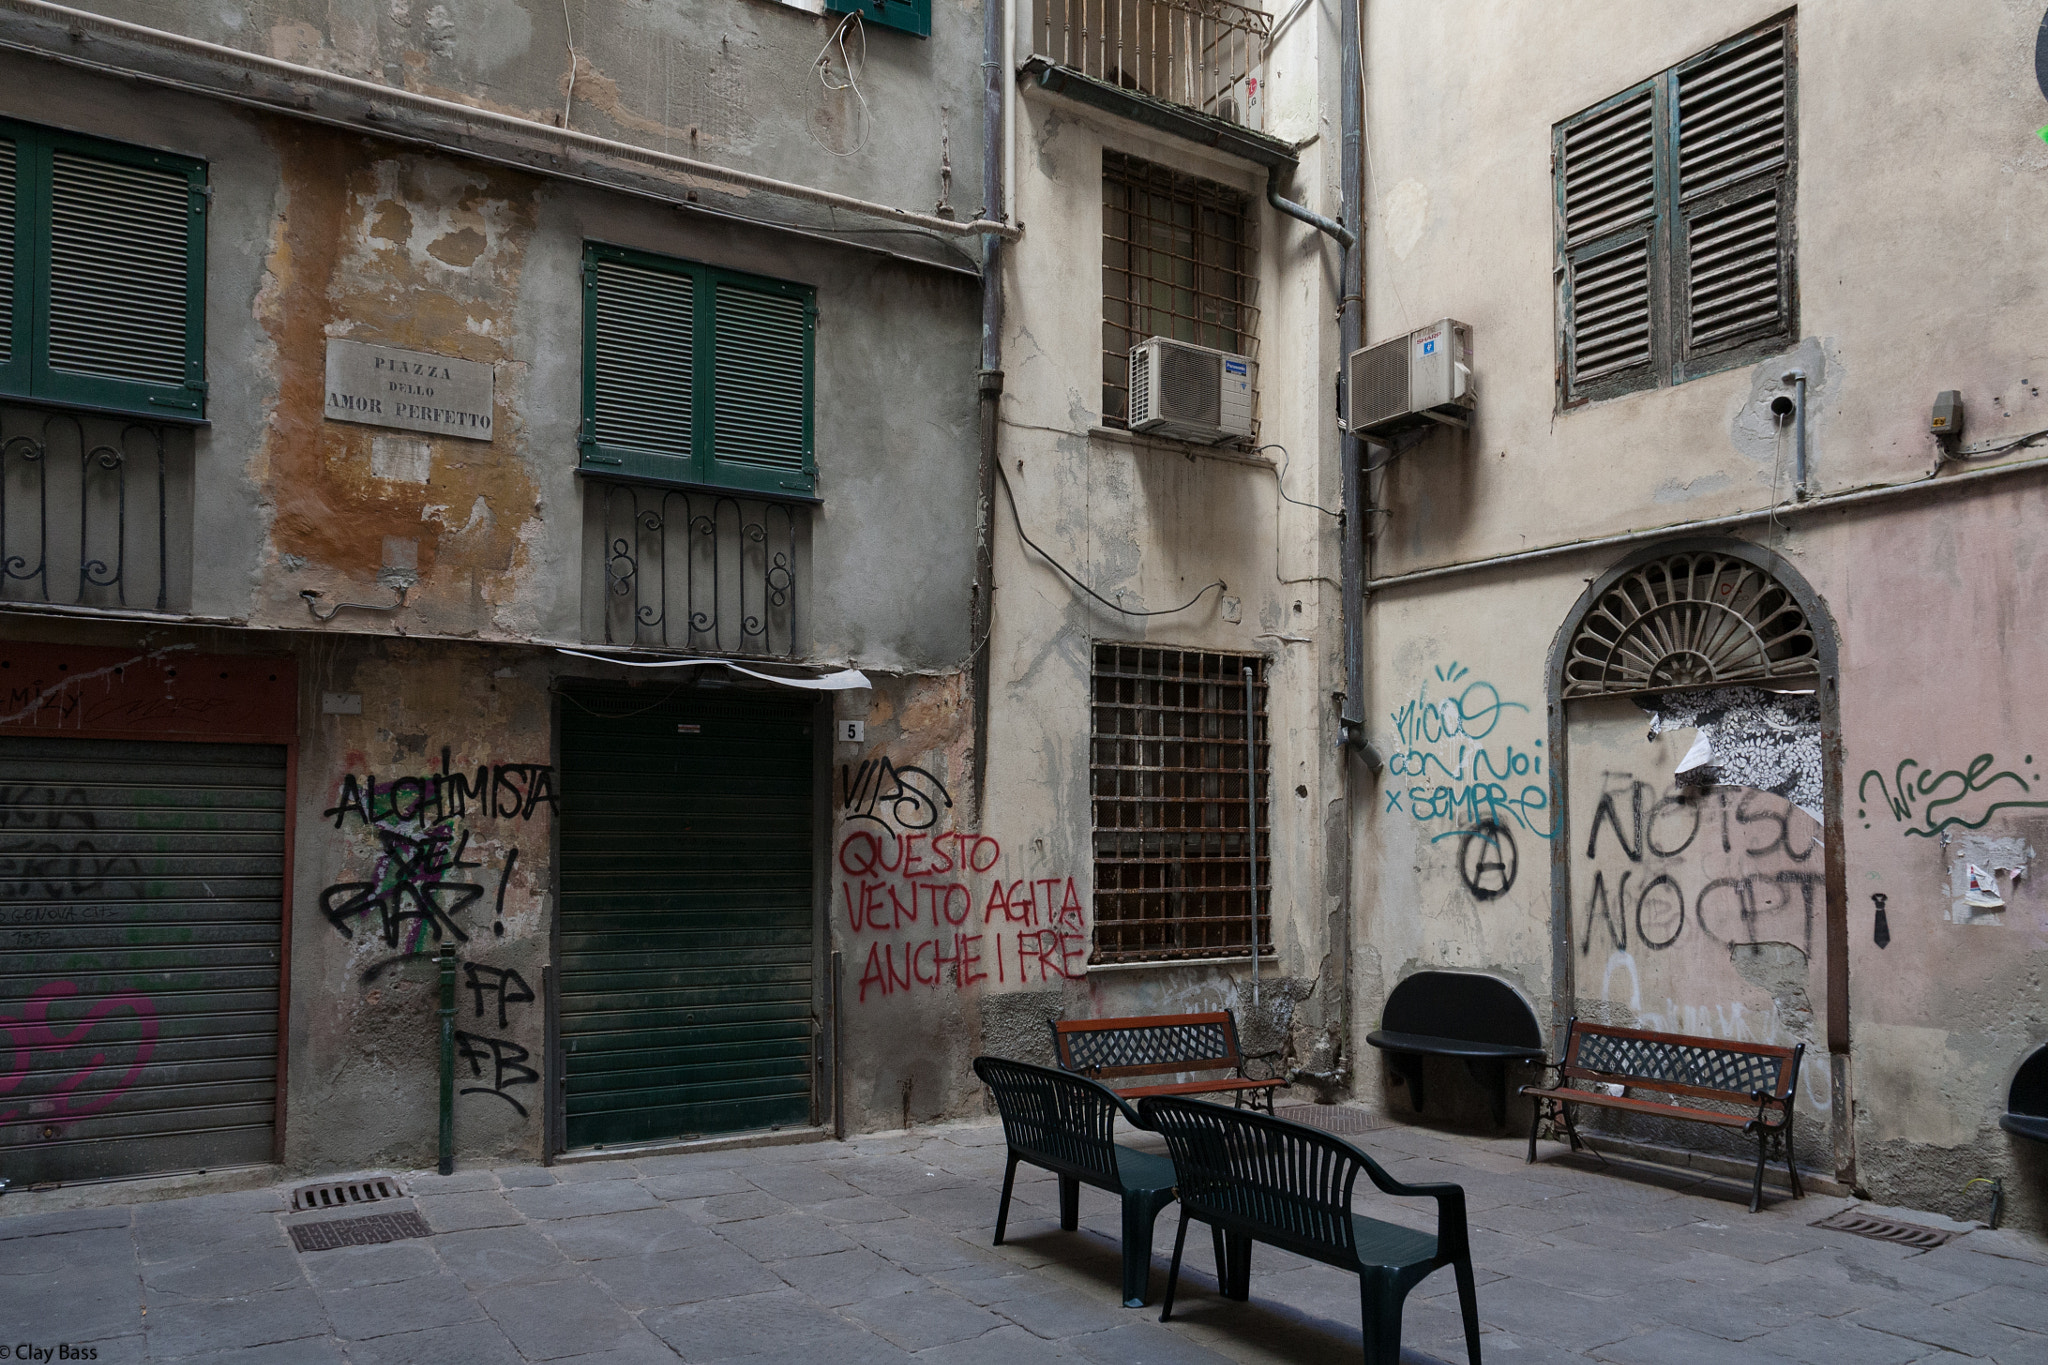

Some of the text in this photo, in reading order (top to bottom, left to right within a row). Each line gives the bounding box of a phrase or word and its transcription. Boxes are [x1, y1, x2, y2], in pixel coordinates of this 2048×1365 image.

[1416, 331, 1442, 345] SHARP
[374, 357, 451, 381] PIAZZA
[389, 381, 435, 398] DELLO
[327, 392, 491, 430] AMOR PERFETTO
[847, 724, 856, 739] 5
[1586, 780, 1700, 862] NO
[838, 831, 1001, 878] QUESTO
[843, 876, 1085, 933] VENTO AGITA
[1582, 870, 1685, 957] NO
[858, 933, 989, 1004] ANCHE
